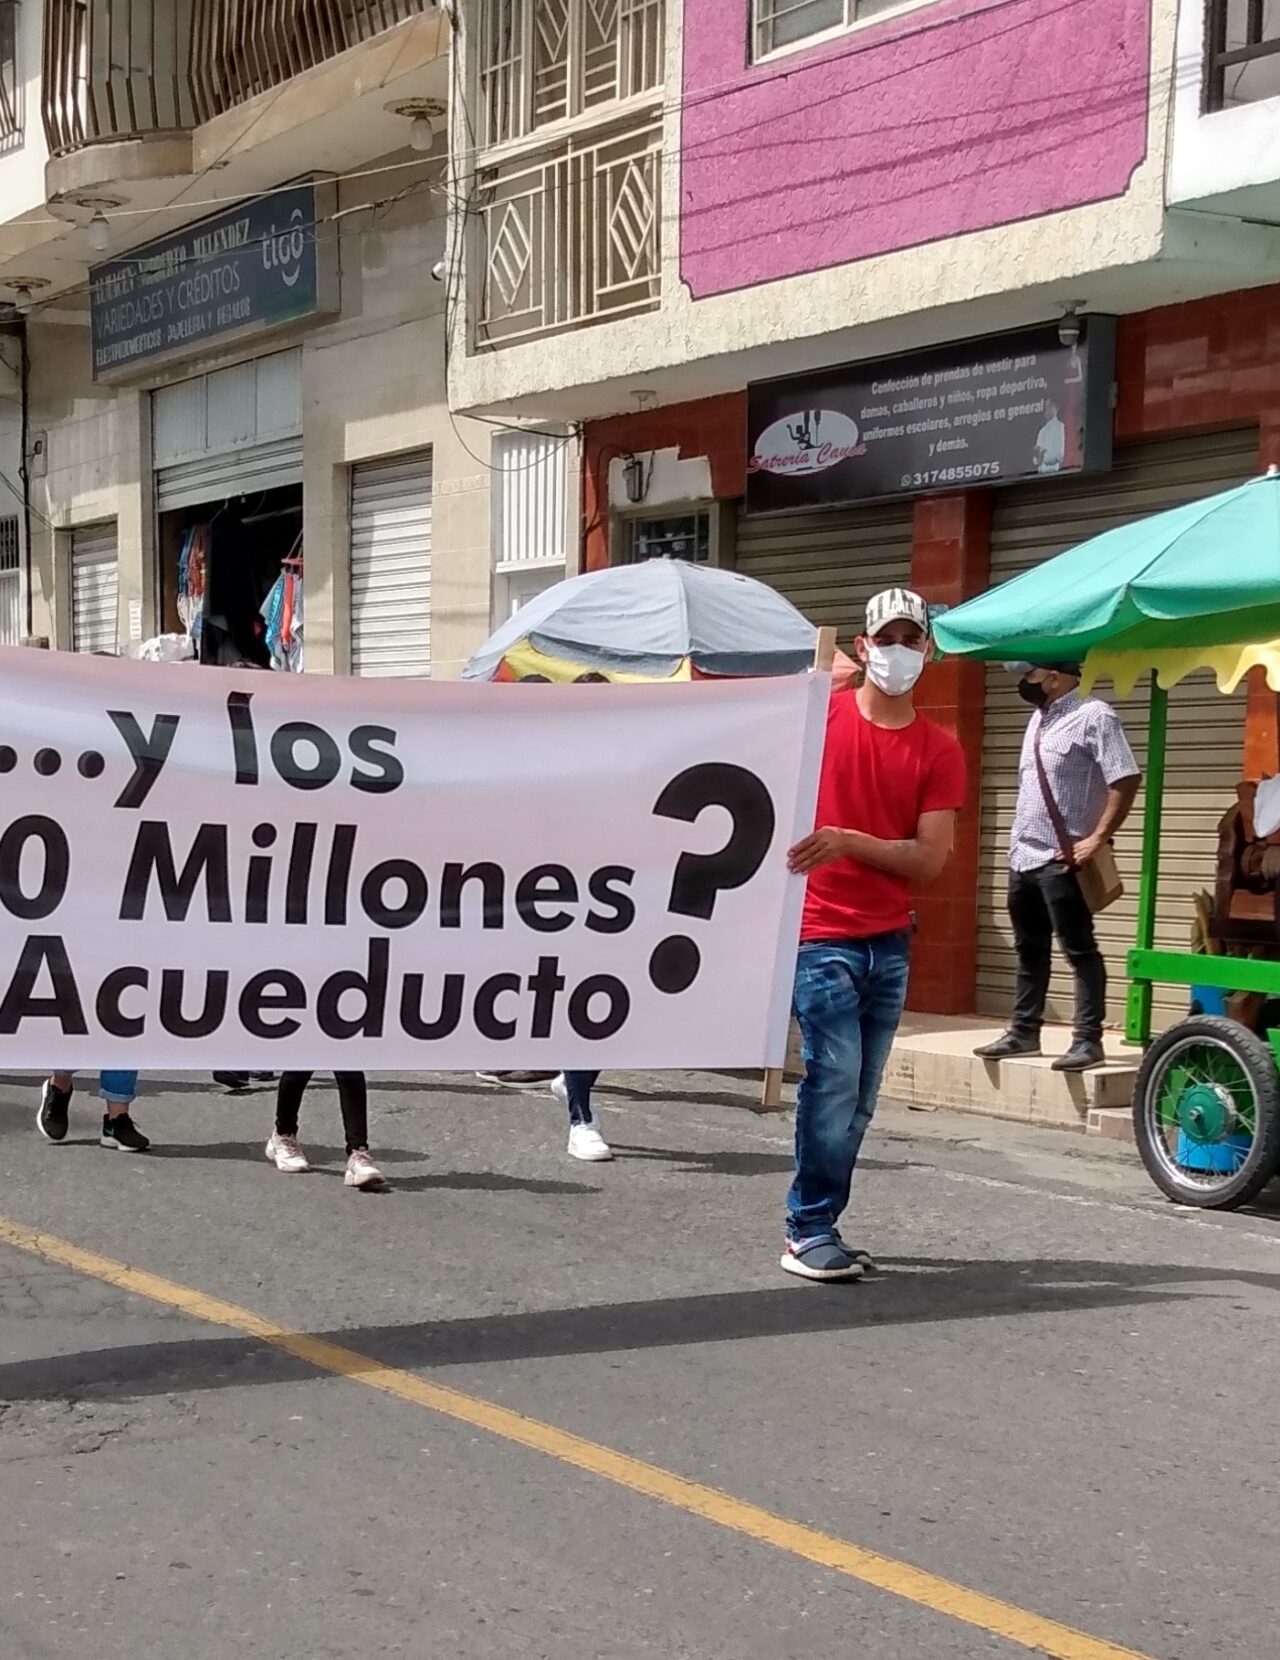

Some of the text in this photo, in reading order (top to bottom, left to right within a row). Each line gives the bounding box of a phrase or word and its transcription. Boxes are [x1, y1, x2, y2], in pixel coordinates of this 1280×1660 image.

[95, 261, 240, 338] VARIEDADES Y CRÉDITOS
[871, 355, 1036, 395] Confección de prendas de vestir para
[862, 424, 904, 441] uniformes
[953, 409, 992, 426] arreglos
[994, 406, 1006, 419] en
[1007, 399, 1044, 419] general
[892, 396, 938, 414] caballeros
[939, 395, 946, 409] y
[976, 384, 997, 400] ropa
[928, 442, 935, 456] y
[913, 461, 1000, 485] 3174855075
[227, 691, 404, 793] los
[119, 820, 635, 934] Millones
[649, 761, 776, 995] ?
